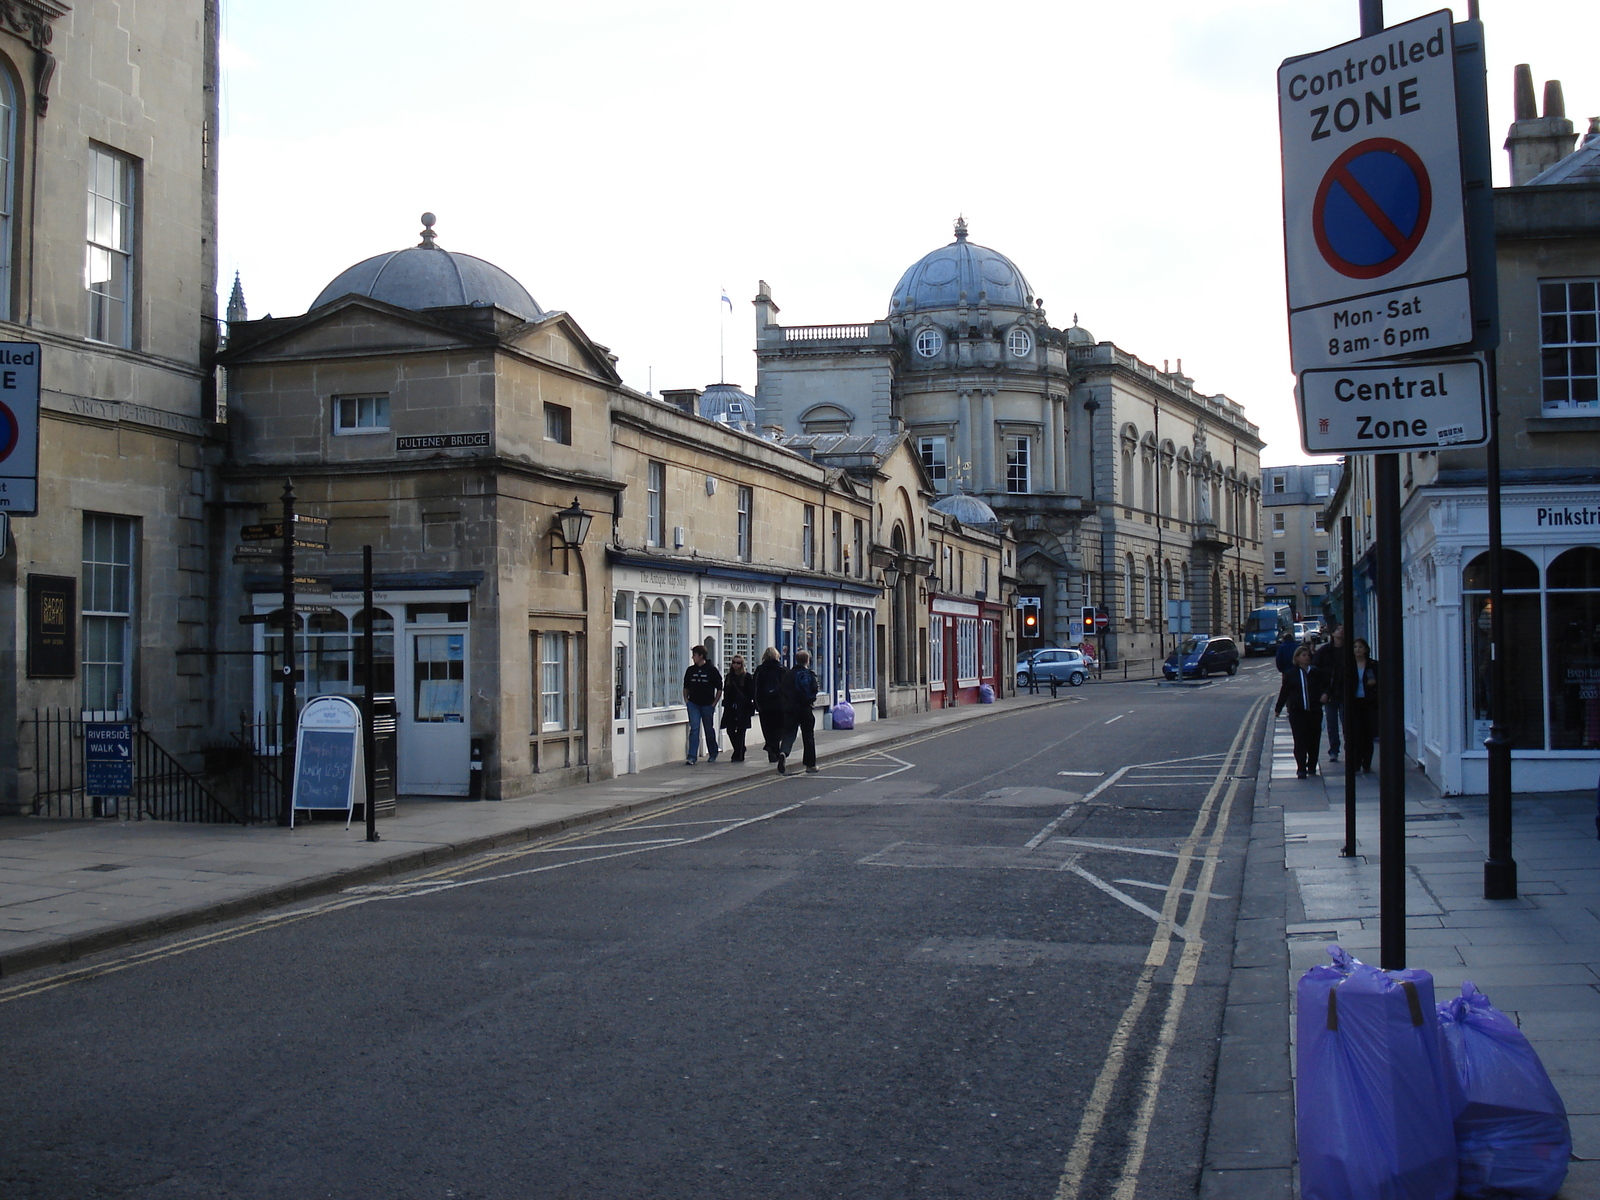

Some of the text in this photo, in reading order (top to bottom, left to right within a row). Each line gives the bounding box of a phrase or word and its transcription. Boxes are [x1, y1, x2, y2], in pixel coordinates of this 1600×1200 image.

[1289, 27, 1444, 101] Controlled
[1310, 77, 1420, 141] ZONE
[1334, 372, 1448, 403] Central
[1356, 416, 1428, 440] Zone
[399, 434, 486, 448] PULTENEY BRIDGE
[640, 571, 648, 583] The
[649, 572, 666, 588] Antique
[667, 573, 676, 589] Map
[676, 575, 687, 590] Shop
[340, 592, 360, 601] Antique
[43, 597, 64, 613] SACCO
[1579, 690, 1598, 699] 2005
[88, 731, 130, 740] RIVERSIDE
[90, 744, 114, 753] WALK
